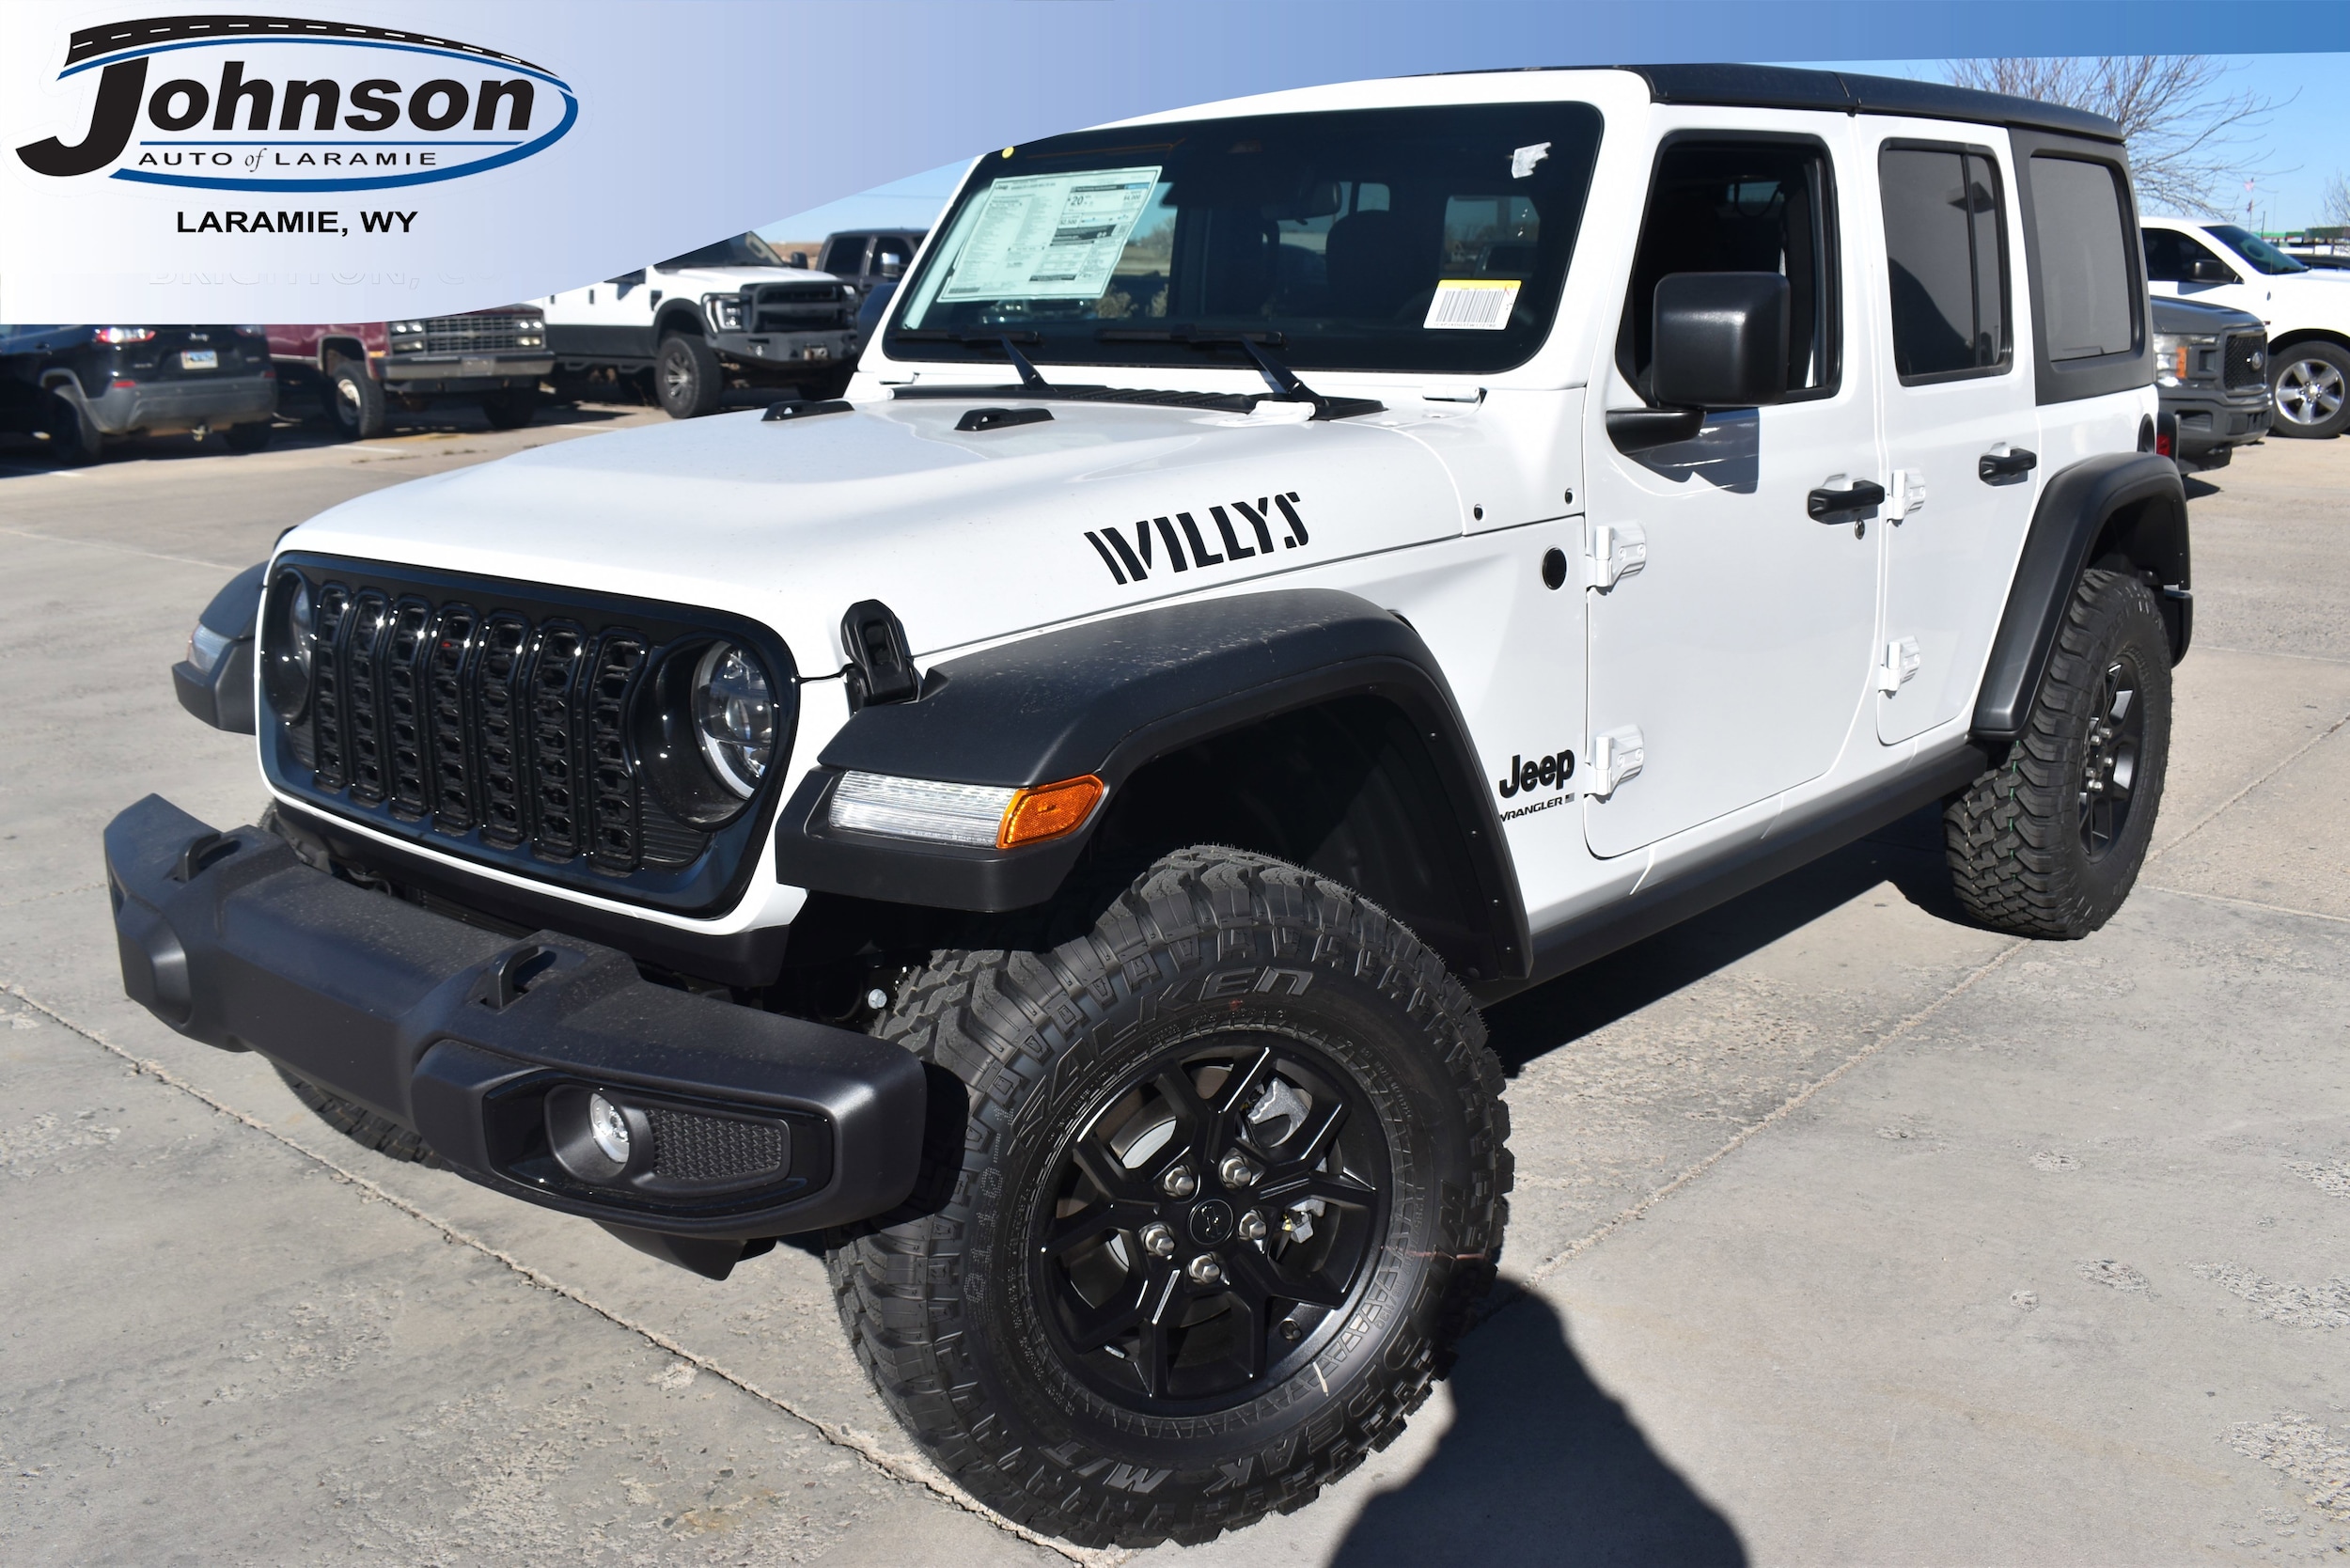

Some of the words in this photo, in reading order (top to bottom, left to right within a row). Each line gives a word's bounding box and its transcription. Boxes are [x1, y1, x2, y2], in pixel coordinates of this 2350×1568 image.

[1084, 492, 1308, 585] WILLYS
[1499, 749, 1574, 799] Jeep
[1007, 965, 1313, 1156] FALKEN
